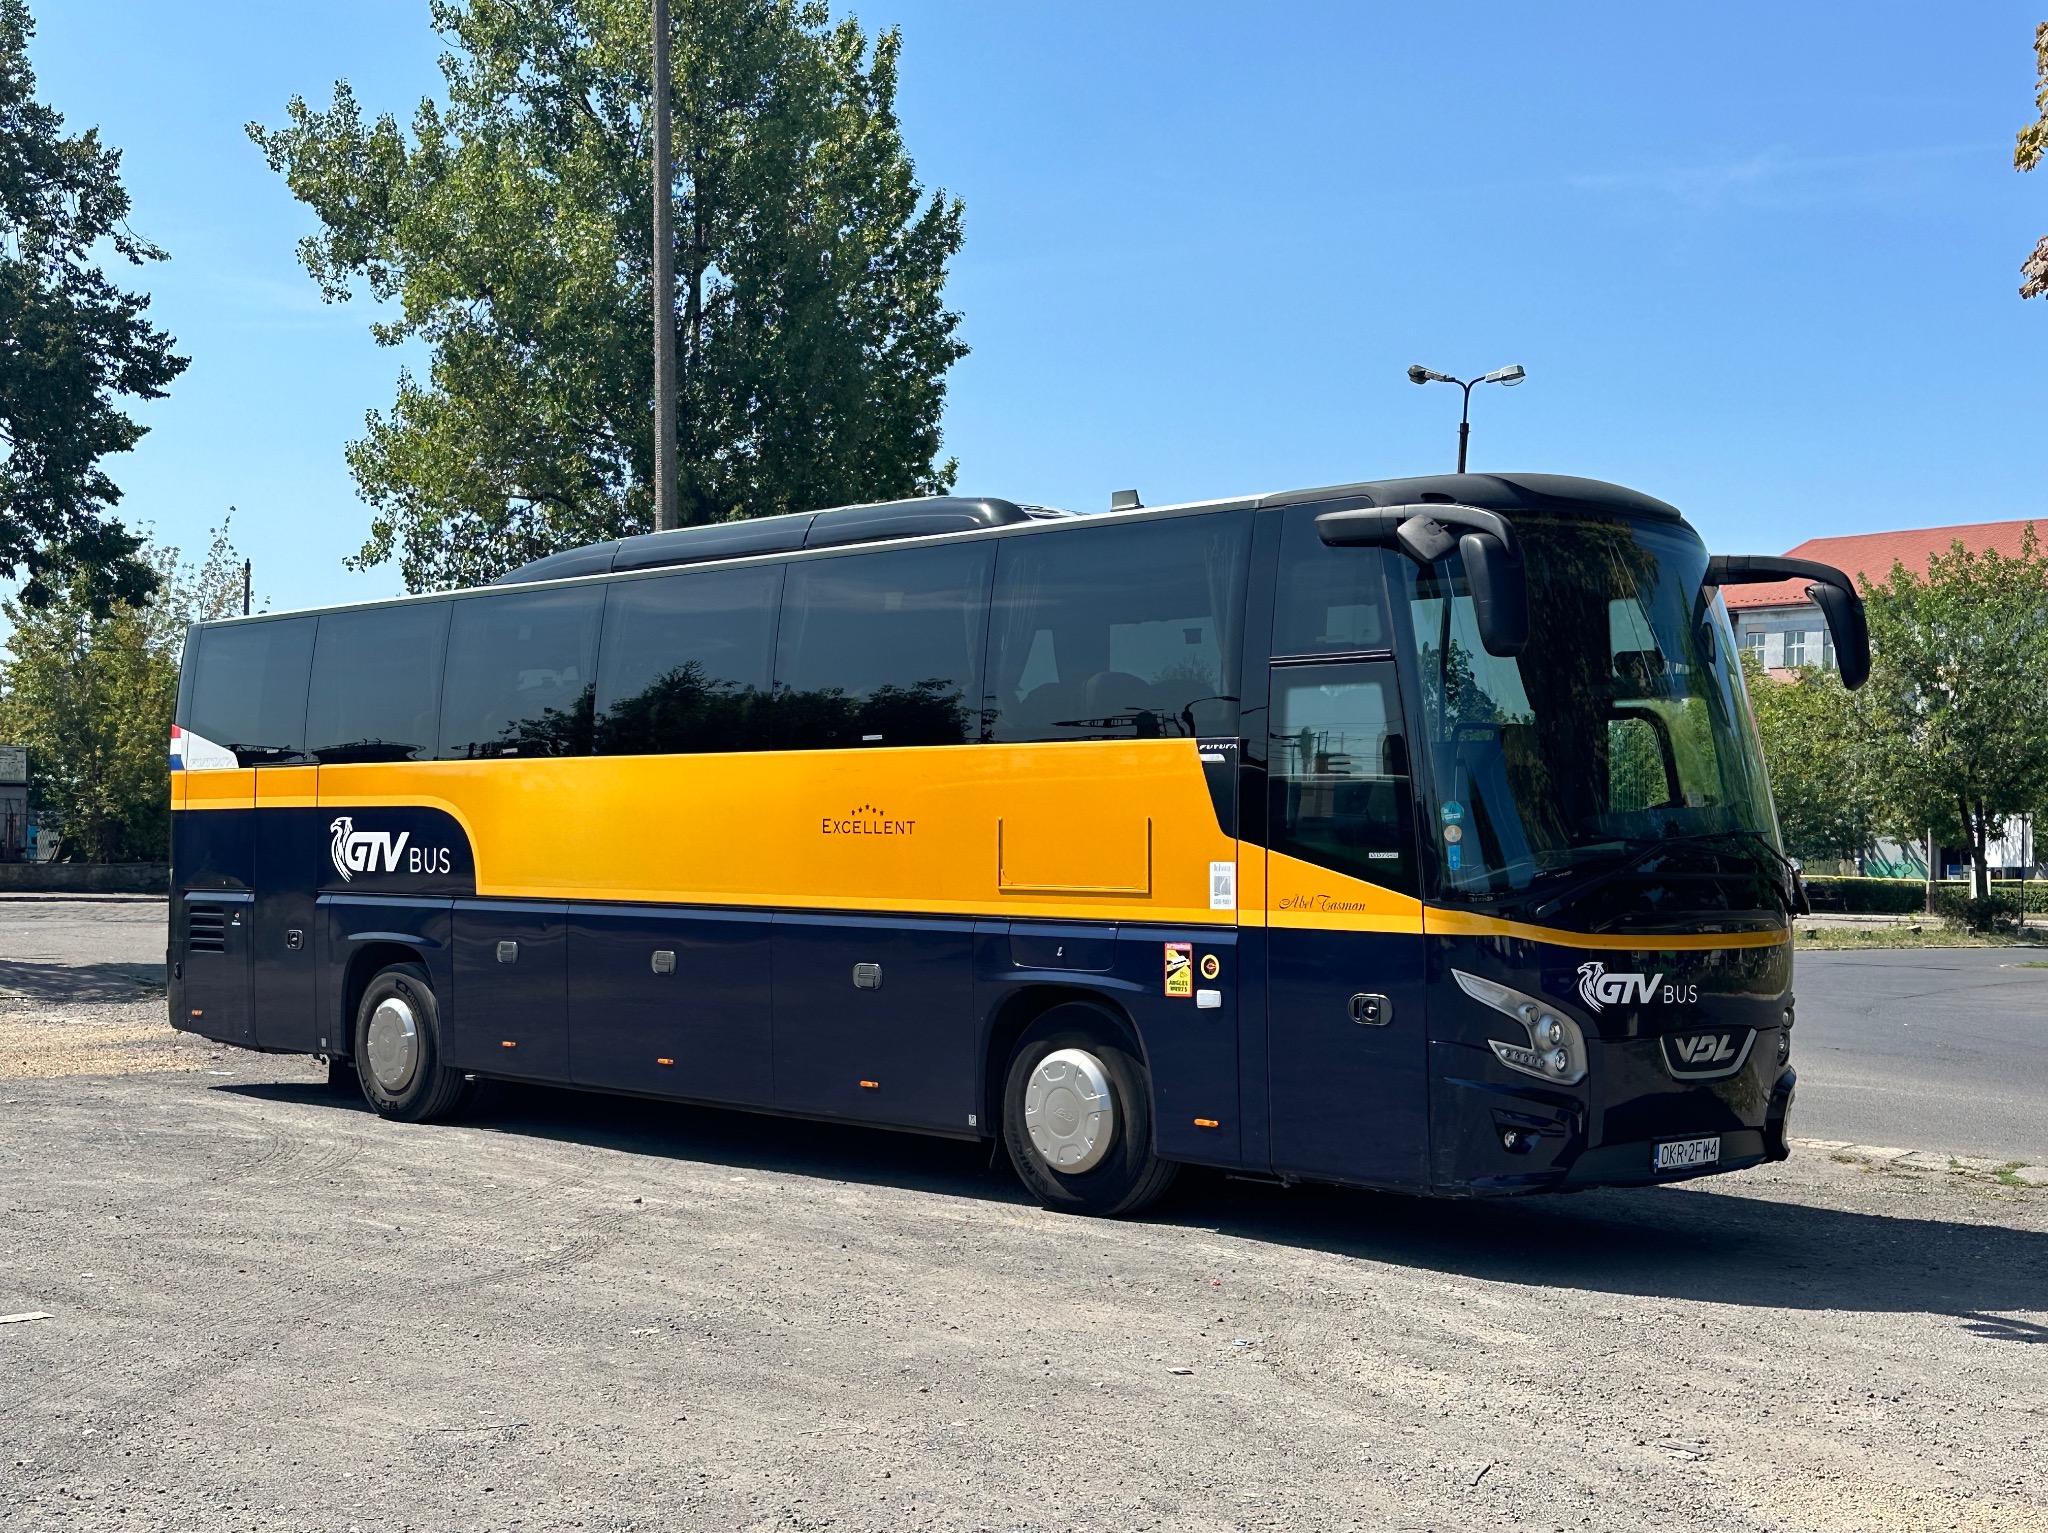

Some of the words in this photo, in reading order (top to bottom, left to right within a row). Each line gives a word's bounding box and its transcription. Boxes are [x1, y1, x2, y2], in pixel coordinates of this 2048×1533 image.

[822, 818, 916, 835] EXCELLENT
[345, 831, 410, 872] GTV
[409, 847, 451, 874] BUS
[1279, 893, 1315, 910] Abel
[1316, 894, 1366, 912] Tasman
[1595, 973, 1664, 1004] GTV
[1663, 984, 1698, 1004] BUS
[1675, 1034, 1736, 1064] VDL
[1661, 1143, 1685, 1166] OKR
[1687, 1138, 1718, 1163] 2FW4
